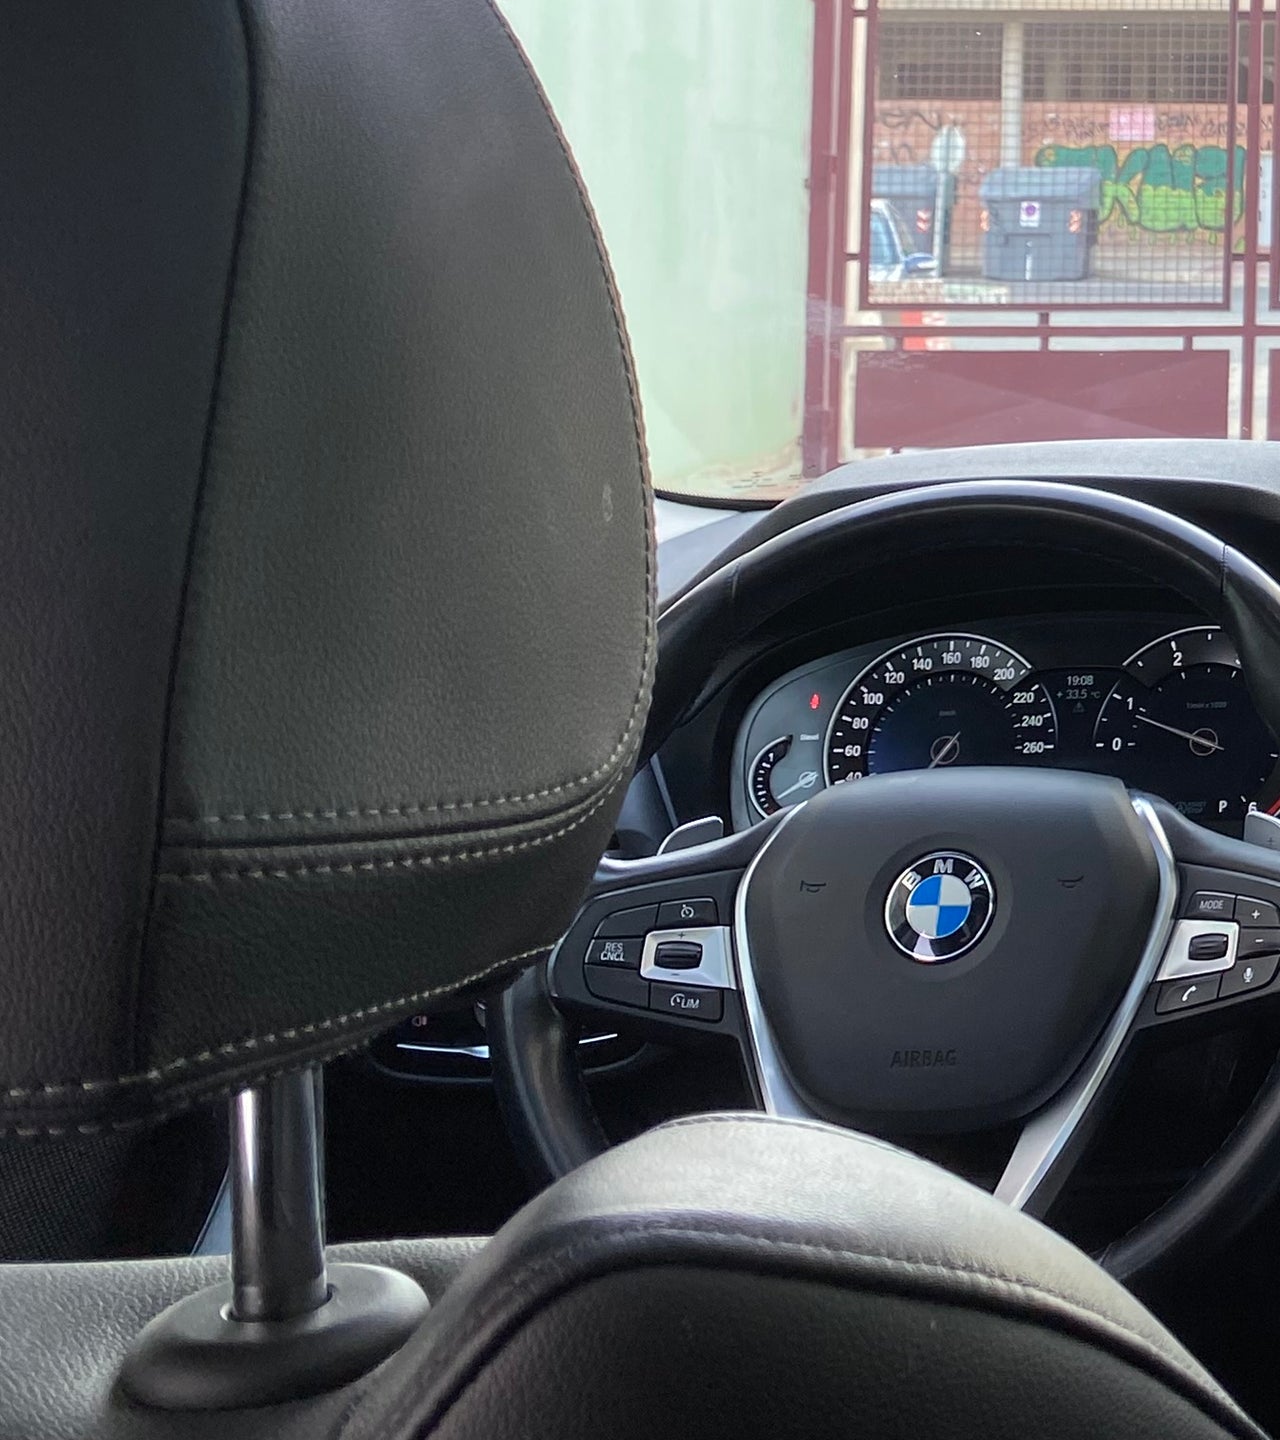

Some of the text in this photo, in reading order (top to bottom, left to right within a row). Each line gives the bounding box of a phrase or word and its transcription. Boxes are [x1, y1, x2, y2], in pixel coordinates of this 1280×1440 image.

[941, 652, 962, 664] 160
[970, 656, 990, 669] 180
[1173, 652, 1183, 666] 2
[912, 658, 932, 671] 140
[884, 671, 905, 684] 120
[993, 667, 1015, 681] 200
[1066, 675, 1094, 686] 19:08
[862, 693, 884, 705] 100
[1013, 692, 1035, 703] 220
[1066, 689, 1088, 699] 33.5
[1126, 697, 1134, 710] 1
[852, 717, 869, 729] 80
[1021, 715, 1043, 727] 240
[1022, 742, 1044, 754] 260
[1111, 738, 1122, 750] 0
[844, 745, 861, 757] 60
[1218, 800, 1228, 813] P
[901, 859, 984, 891] BMW
[1199, 900, 1224, 910] MODE
[604, 942, 624, 952] RES
[600, 951, 625, 961] CNCL
[681, 998, 700, 1009] LIM
[890, 1049, 957, 1068] AIRBAG
